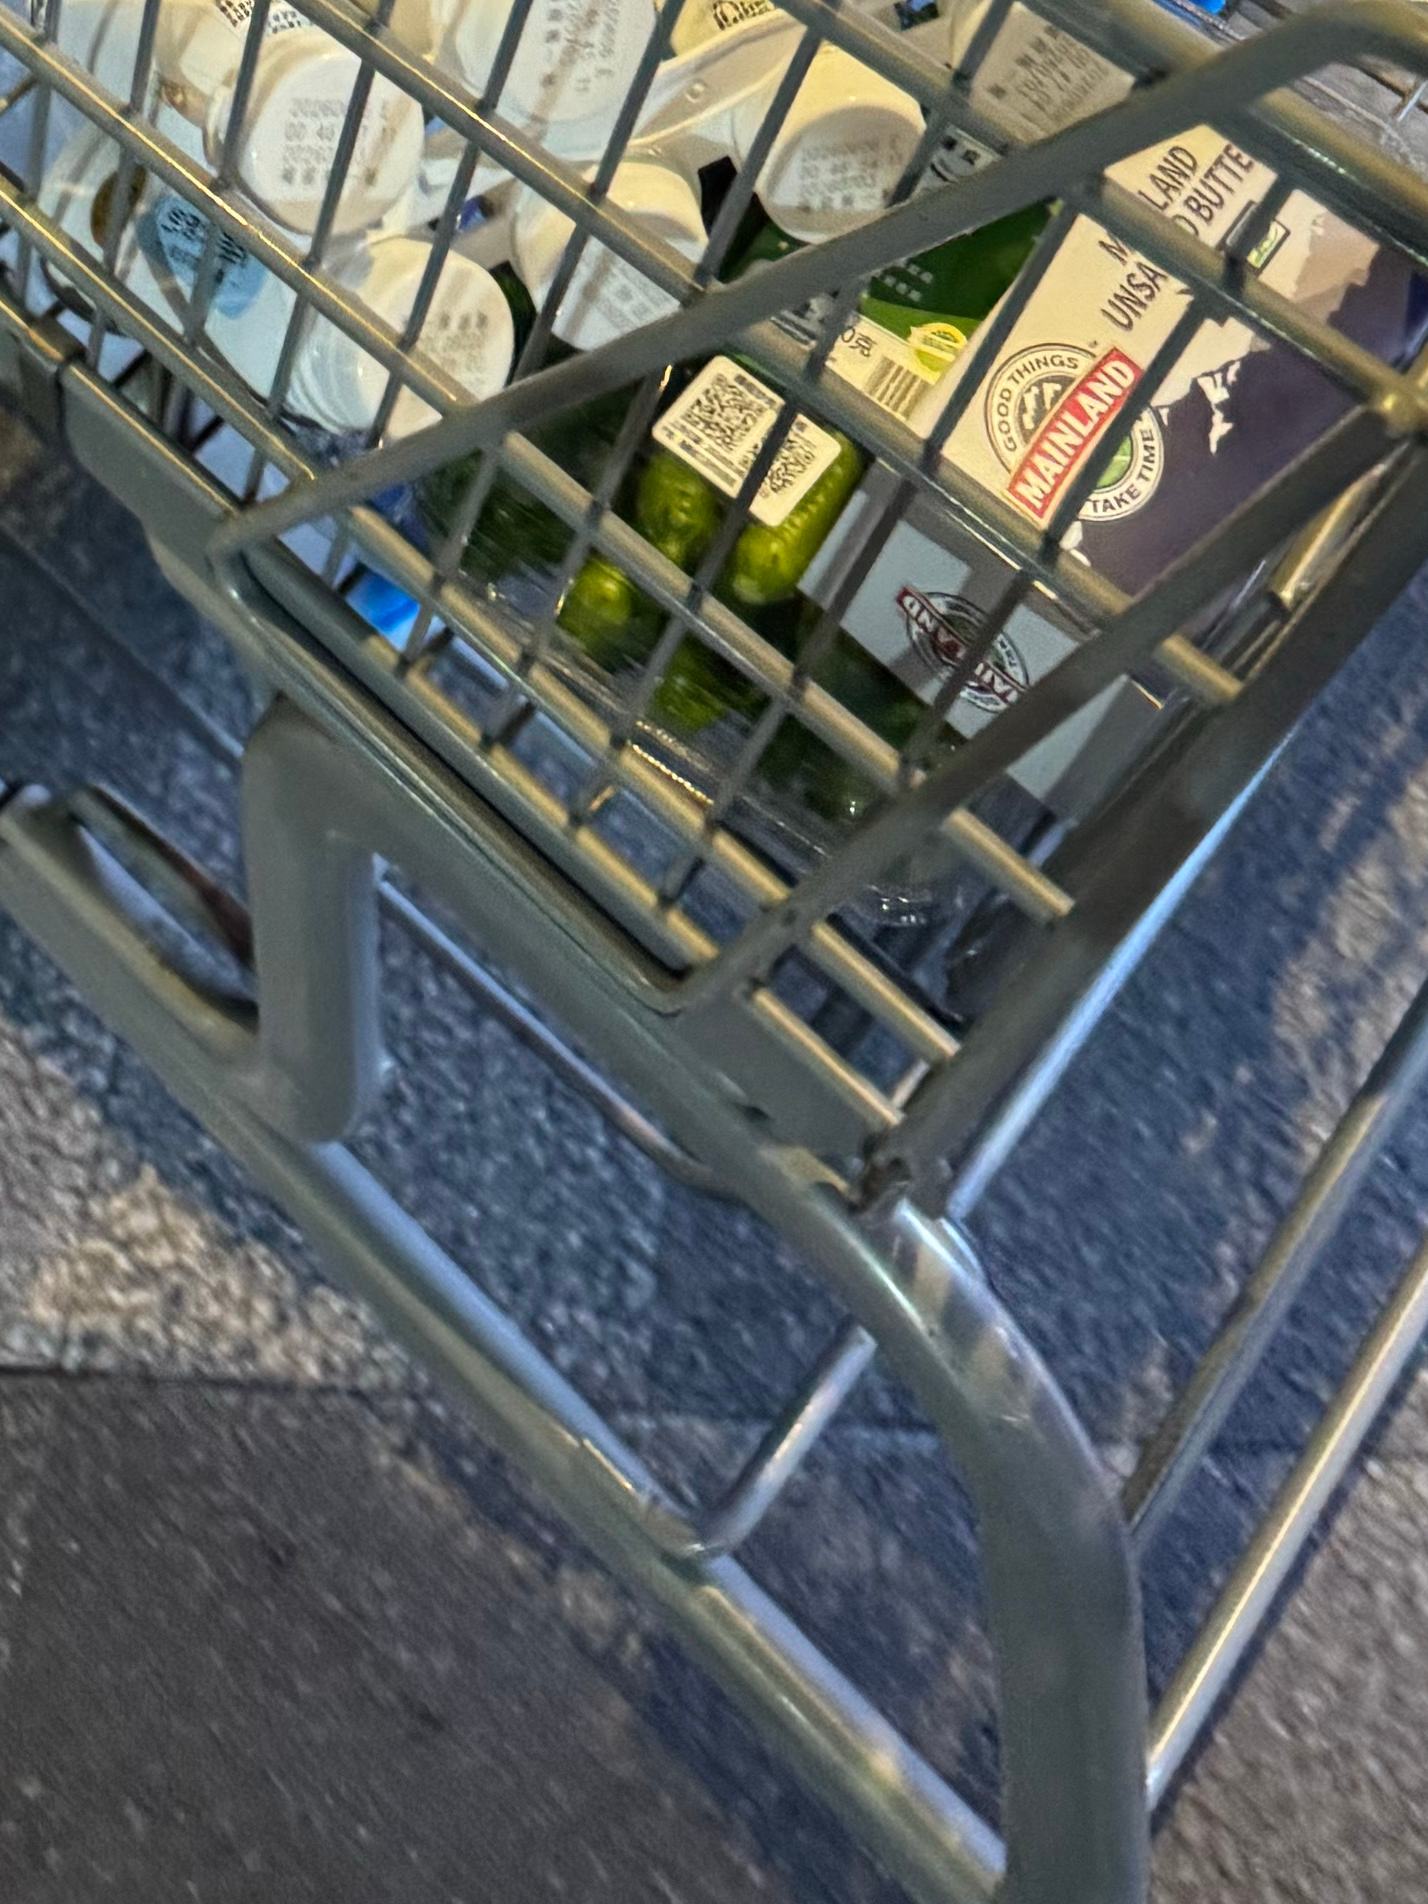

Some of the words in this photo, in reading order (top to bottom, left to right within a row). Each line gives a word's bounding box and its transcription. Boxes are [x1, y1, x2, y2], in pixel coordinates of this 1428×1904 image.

[1186, 143, 1255, 224] BUTTE
[995, 387, 1020, 452] GOOD
[1008, 353, 1080, 385] THINGS
[1014, 357, 1136, 510] MAINLAND
[1088, 487, 1141, 515] TAKE
[1140, 427, 1157, 483] TIME
